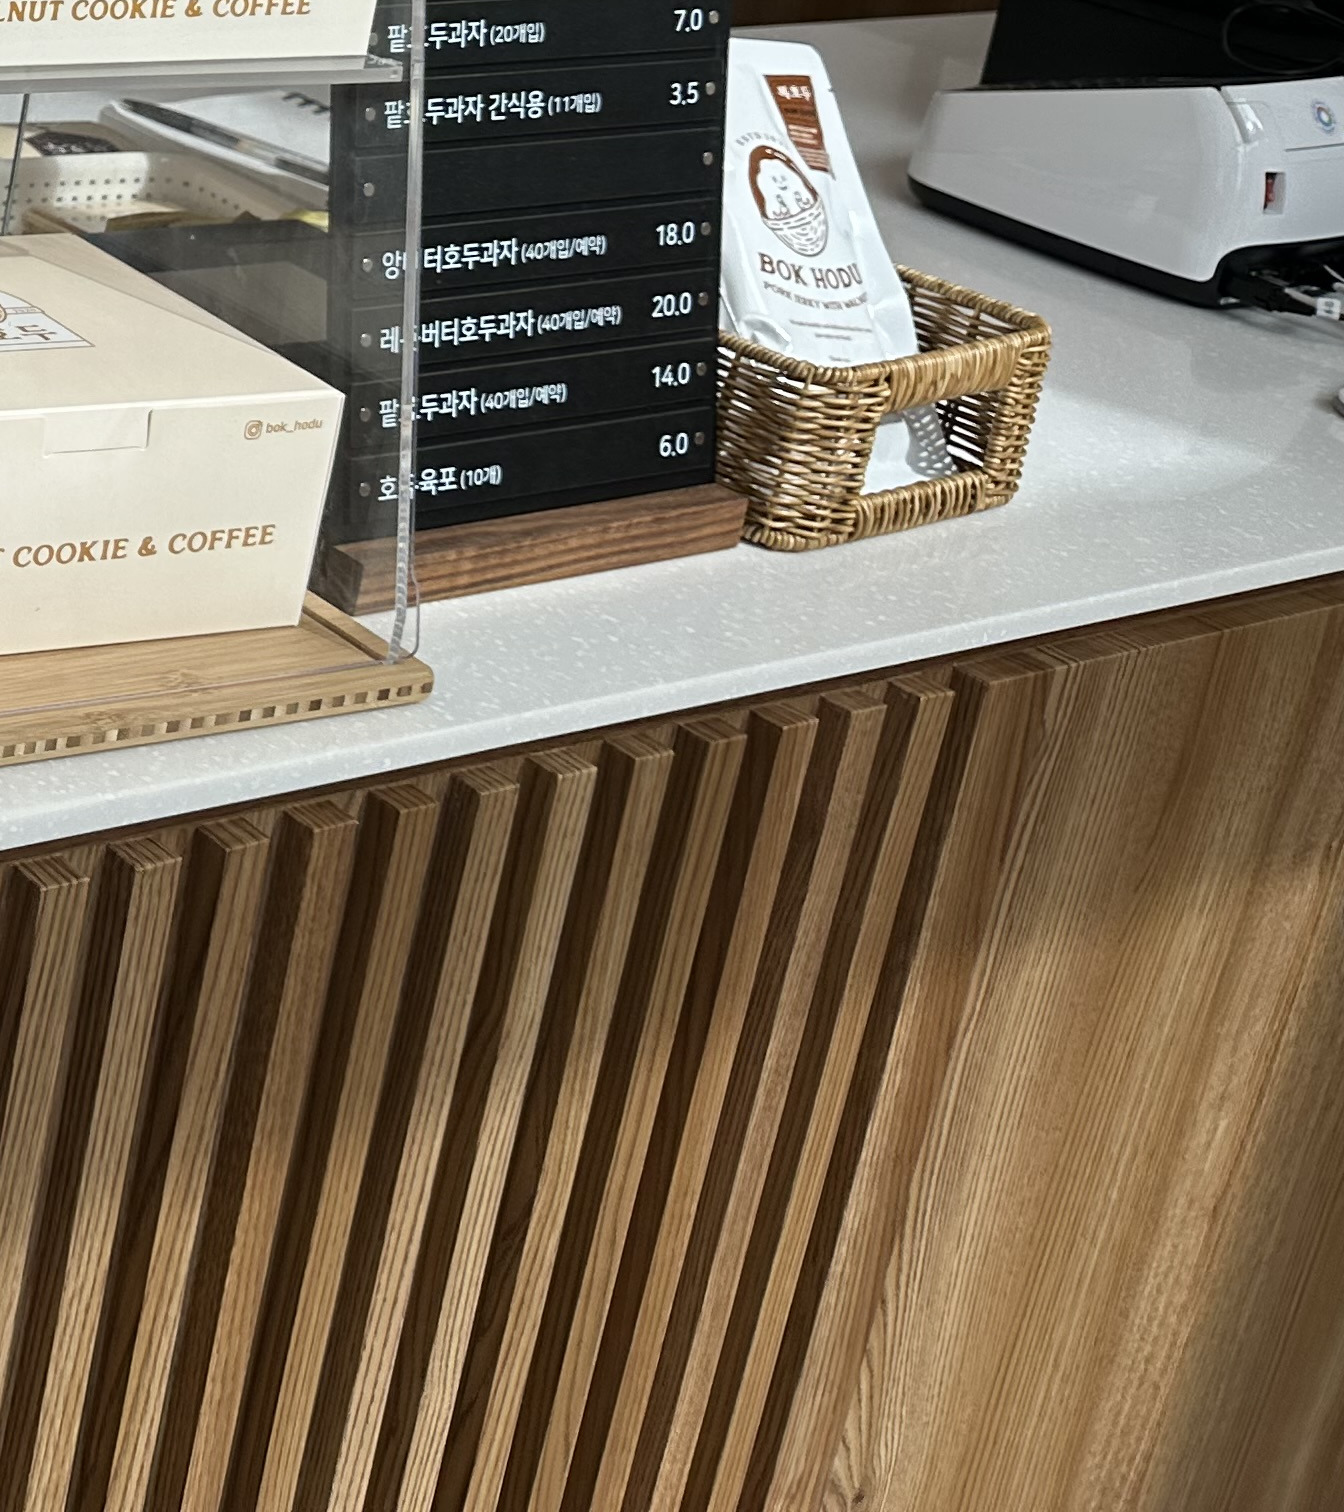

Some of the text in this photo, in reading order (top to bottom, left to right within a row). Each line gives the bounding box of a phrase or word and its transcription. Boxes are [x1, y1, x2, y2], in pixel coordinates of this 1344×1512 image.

[387, 8, 704, 54] 팥두과자 (20개입) 7.0
[487, 90, 547, 122] 간식용
[548, 92, 603, 117] (11개입)
[669, 81, 699, 106] 3.5
[381, 221, 696, 280] 앙터호두과자 (40개입/예약) 18.0
[758, 252, 863, 289] BOK HODU
[536, 305, 624, 335] (40개입/예약)
[651, 292, 693, 319] 20.0
[479, 383, 569, 413] (40개입/예약)
[651, 362, 691, 388] 14.0
[266, 419, 323, 434] bok_hodu
[459, 464, 503, 490] (10개)
[658, 432, 689, 458] 6.0
[12, 538, 130, 568] COOKIE
[138, 536, 157, 557] &
[168, 524, 276, 554] COFFEE
